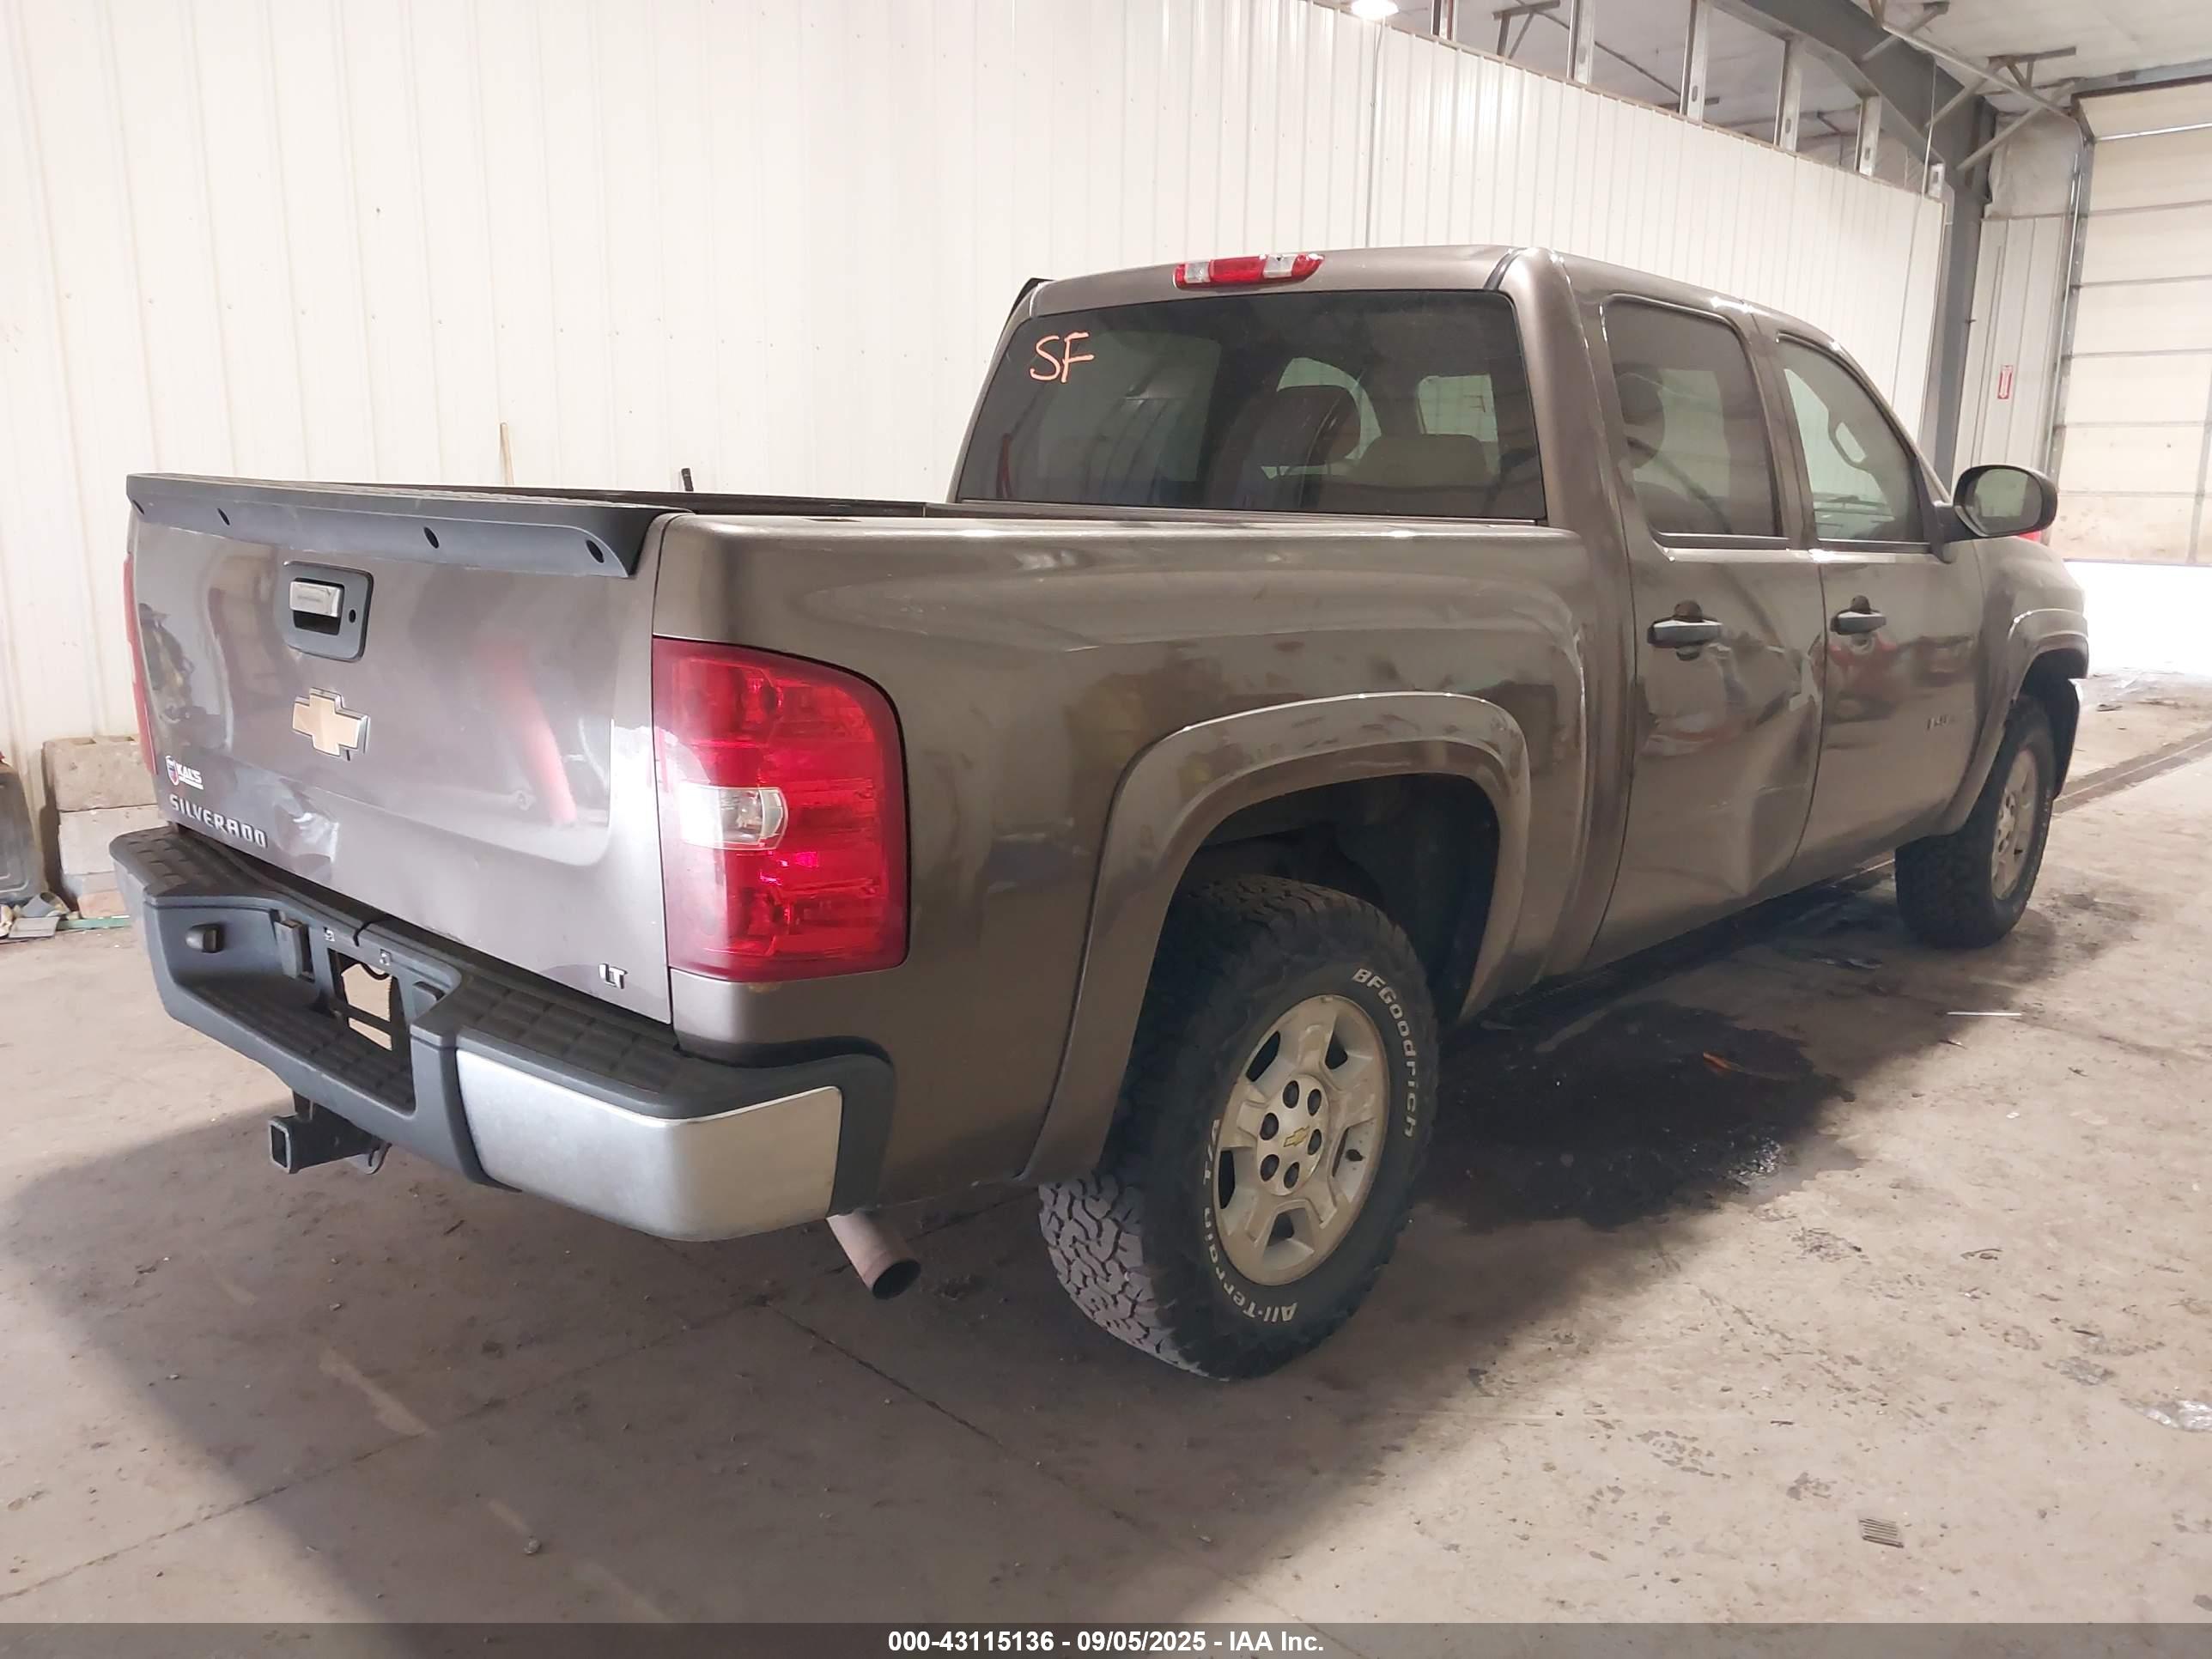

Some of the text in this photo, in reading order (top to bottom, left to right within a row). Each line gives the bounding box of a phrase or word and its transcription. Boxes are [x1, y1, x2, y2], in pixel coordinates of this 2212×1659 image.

[1030, 331, 1095, 383] SF
[169, 793, 268, 848] SILVERADO
[599, 963, 628, 989] LT
